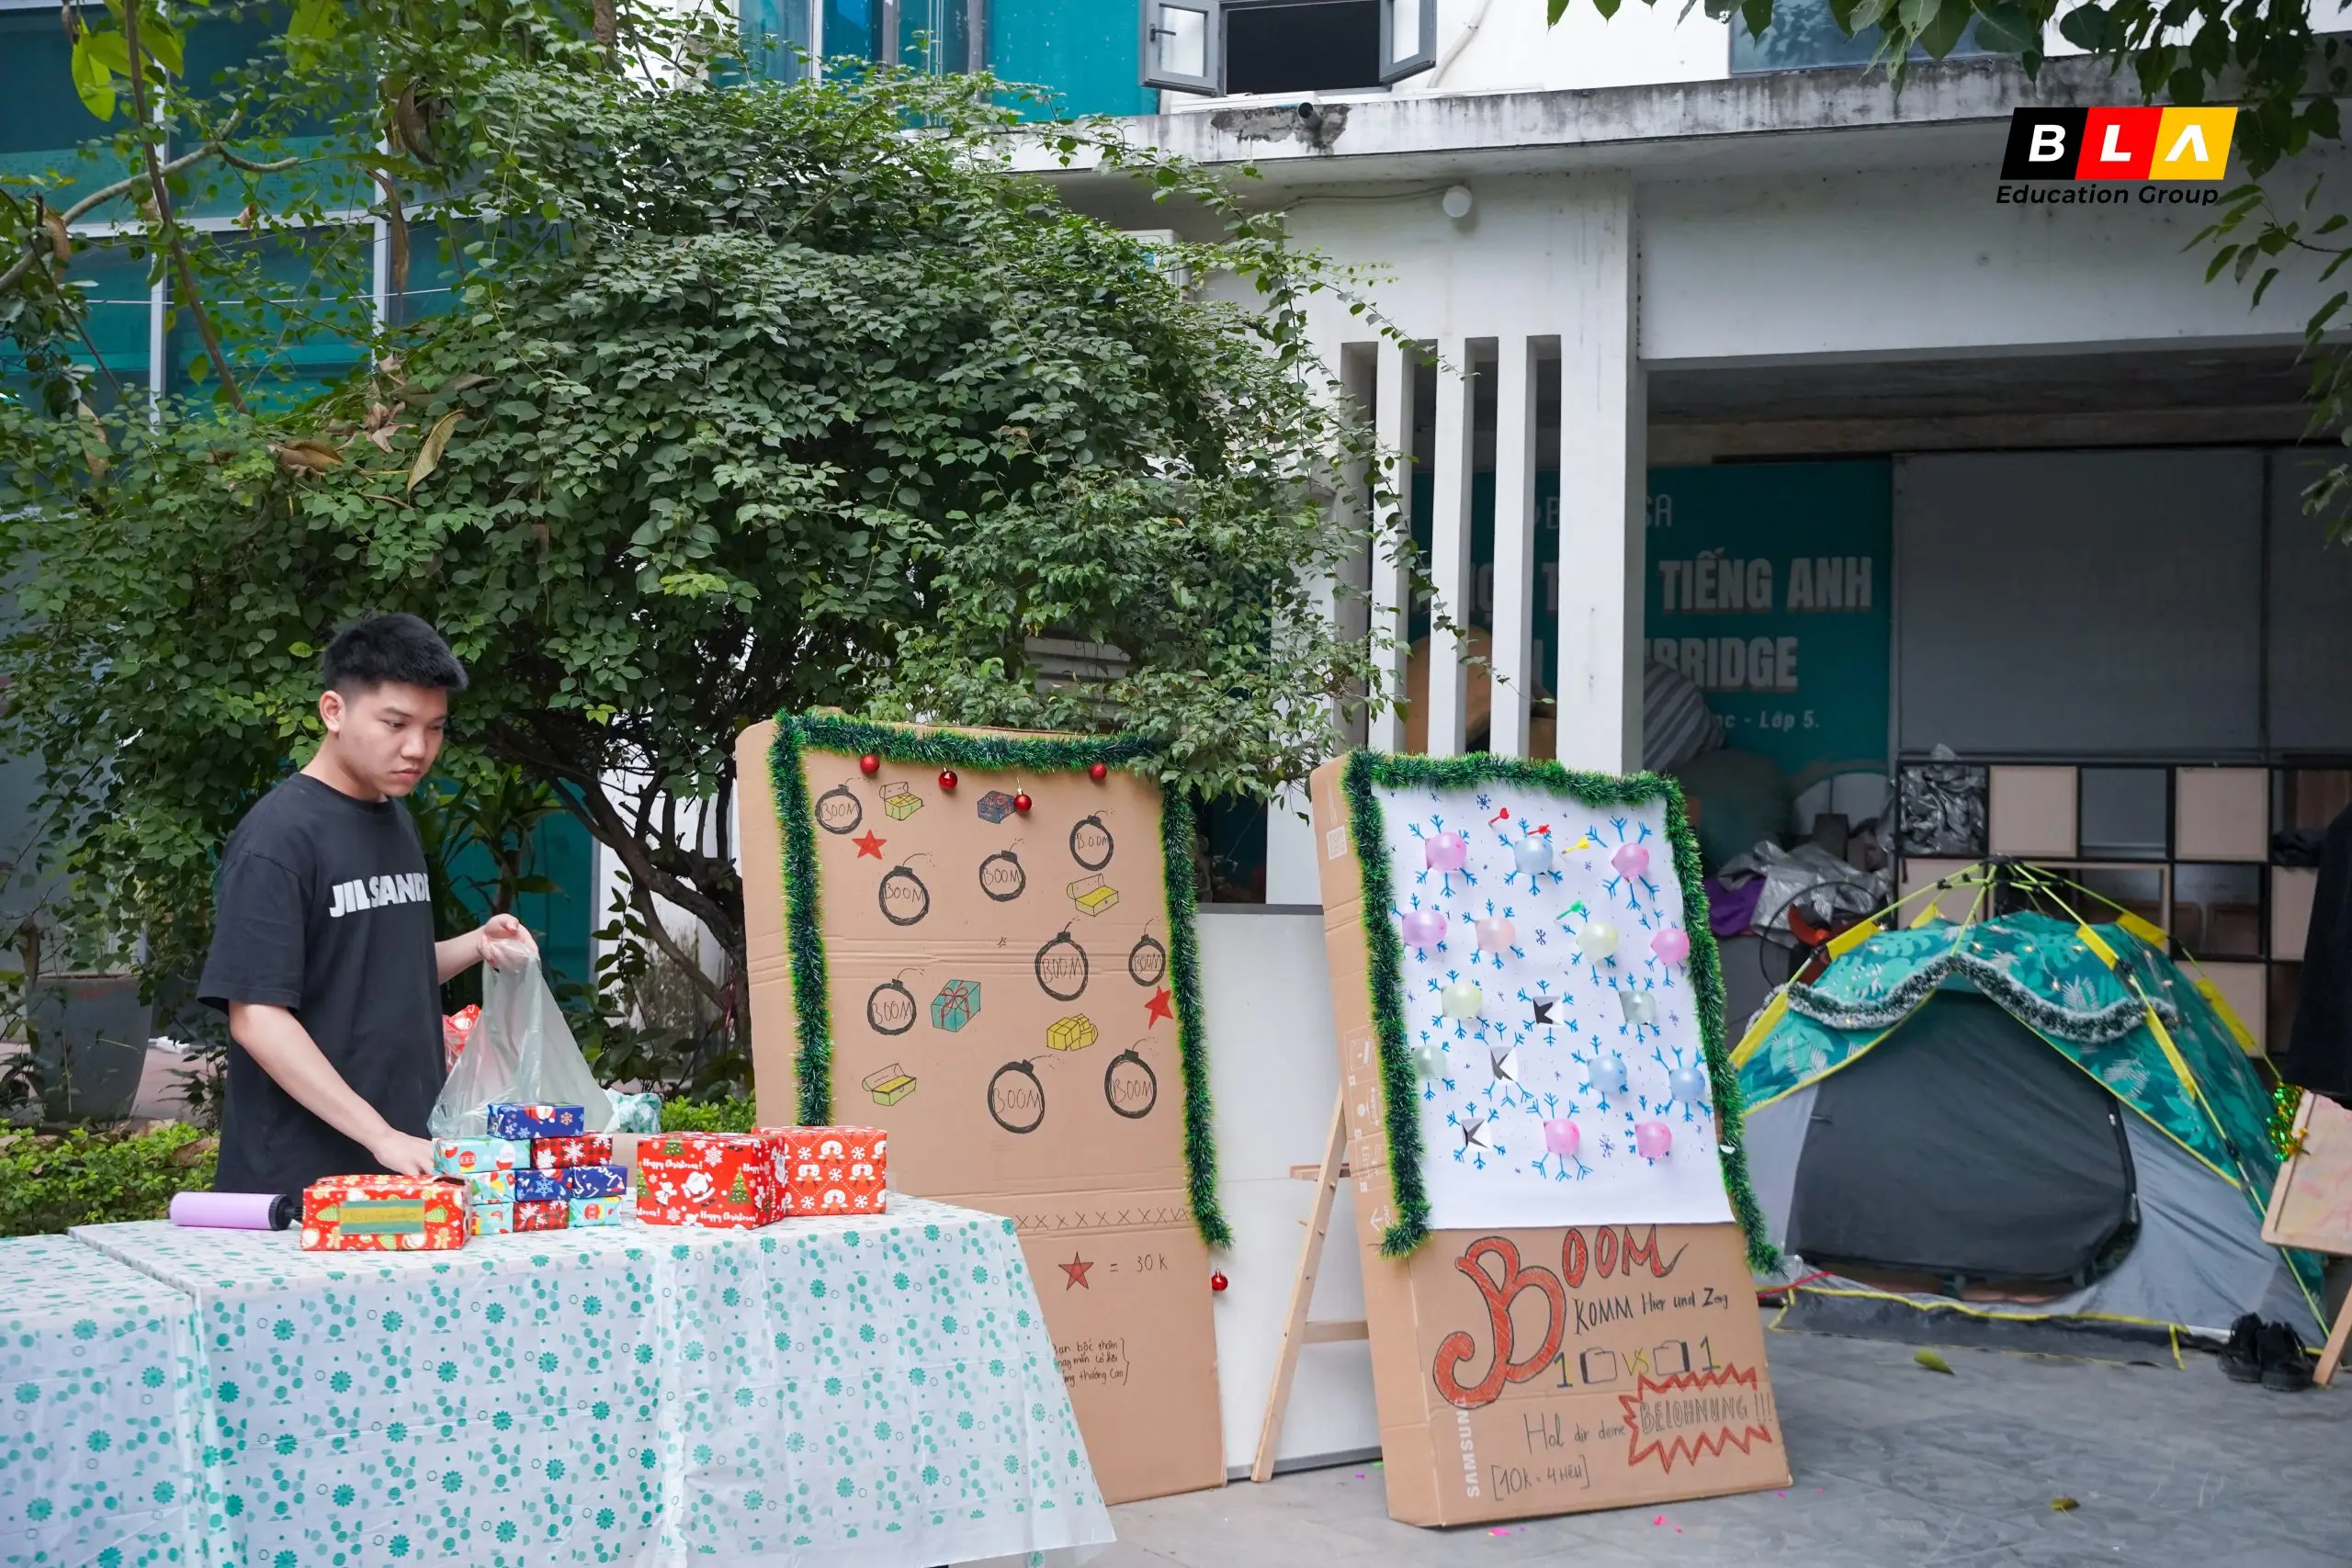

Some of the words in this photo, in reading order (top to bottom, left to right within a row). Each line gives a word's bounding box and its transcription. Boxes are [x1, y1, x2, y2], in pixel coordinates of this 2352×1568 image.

[1659, 548, 1773, 611] TIẾNG
[1787, 557, 1872, 610] ANH
[1645, 637, 1799, 690] BRIDGE
[885, 883, 924, 903] BOOM
[983, 868, 1022, 886] BOOM
[1042, 955, 1083, 983] BOOM
[872, 1000, 912, 1025] BOOM
[994, 1088, 1042, 1113] BOOM
[1113, 1078, 1153, 1103] BOOM
[1432, 1224, 1689, 1409] BOOM
[1572, 1295, 1634, 1335] KOMM
[1673, 1291, 1695, 1308] und
[1455, 1397, 1480, 1499] SAMSUN
[1523, 1412, 1564, 1455] Hol
[1574, 1422, 1589, 1443] dir
[1598, 1419, 1625, 1440] deine
